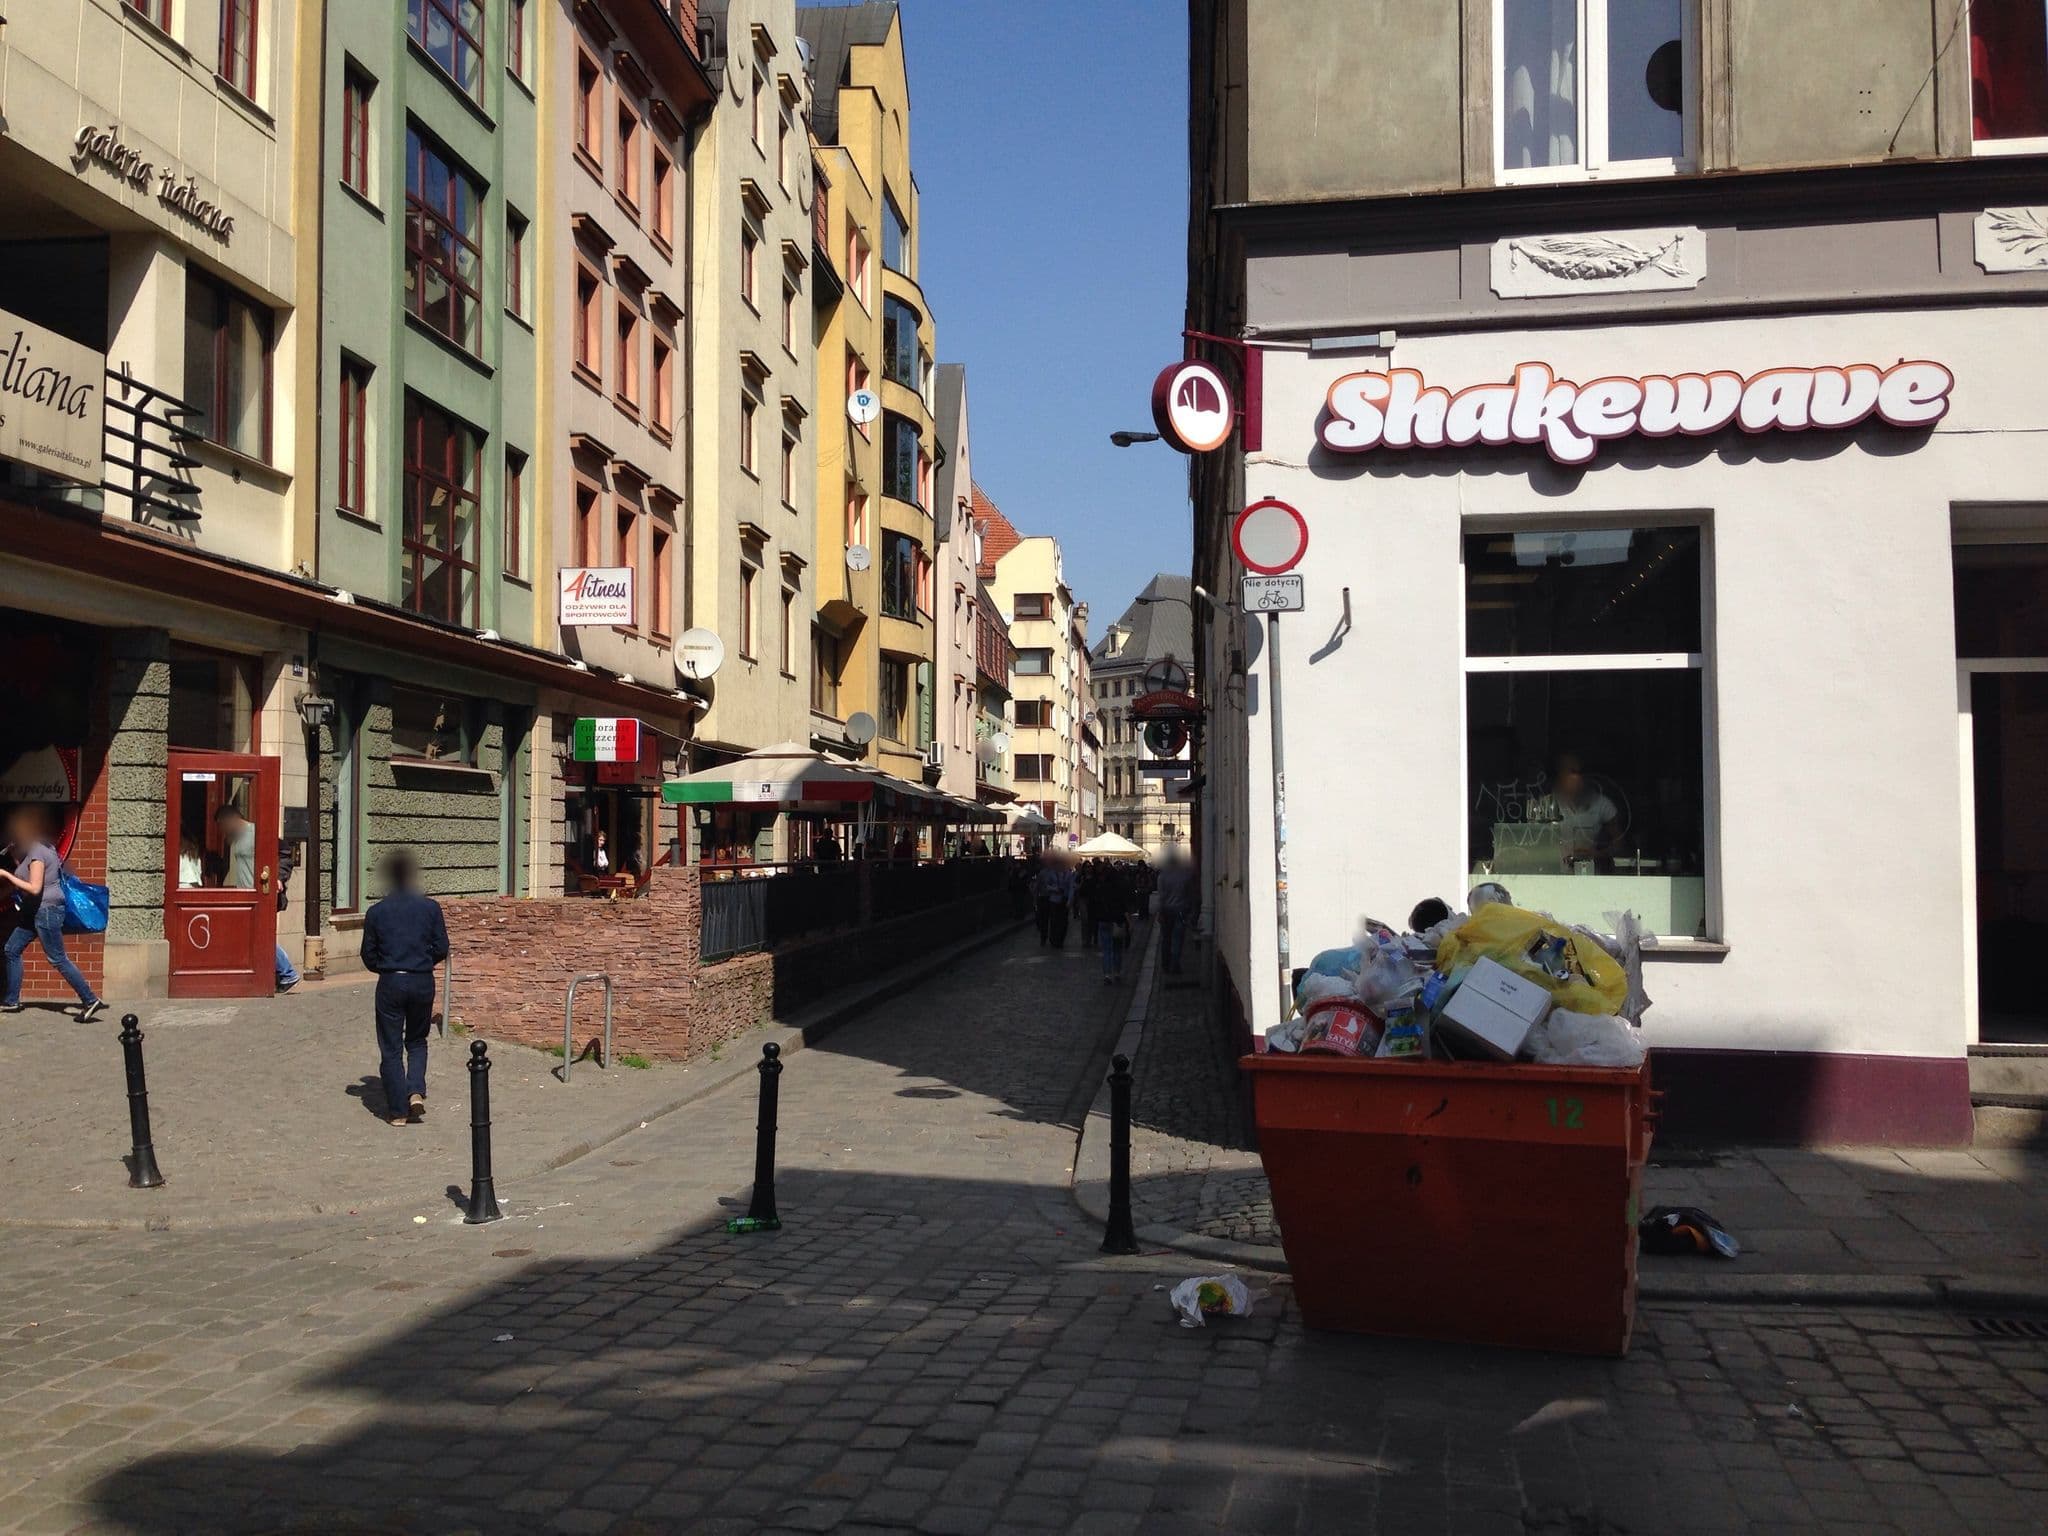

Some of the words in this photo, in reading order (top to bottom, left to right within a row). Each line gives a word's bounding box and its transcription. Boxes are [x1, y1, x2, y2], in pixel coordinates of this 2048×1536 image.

[71, 125, 153, 182] galeria
[157, 167, 234, 235] italiana
[0, 331, 94, 419] liana
[1322, 361, 1954, 464] Shakewave
[564, 570, 626, 601] 4fitness
[1265, 579, 1299, 587] dotyczy
[586, 733, 626, 744] pizzeria
[1544, 1098, 1584, 1128] 12
